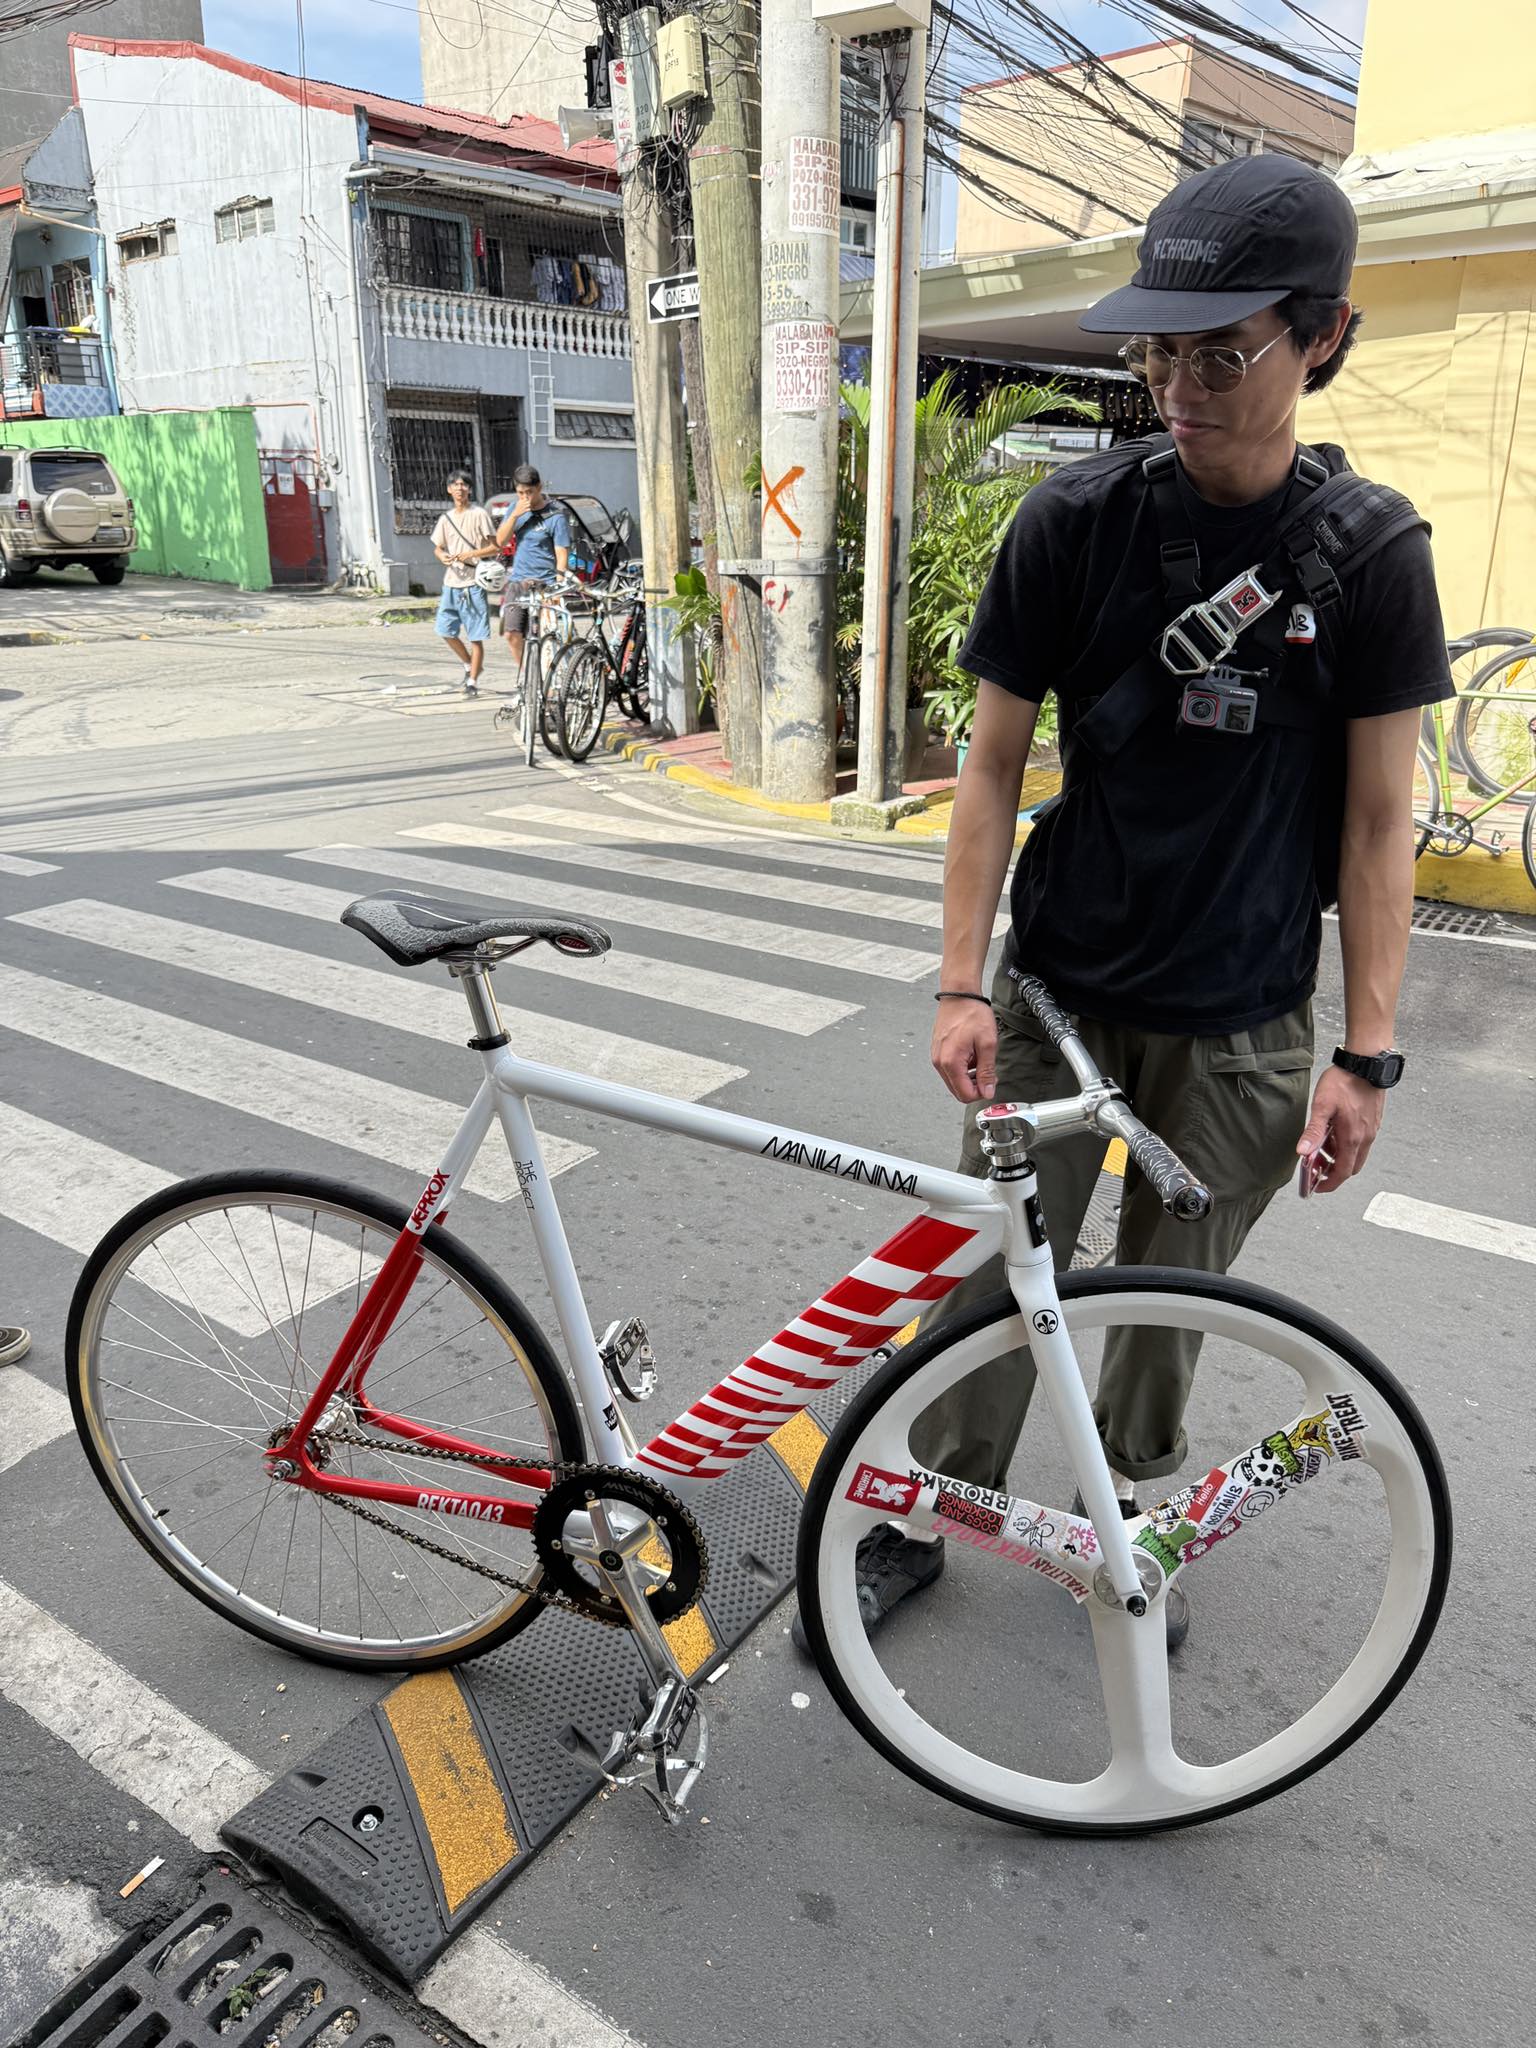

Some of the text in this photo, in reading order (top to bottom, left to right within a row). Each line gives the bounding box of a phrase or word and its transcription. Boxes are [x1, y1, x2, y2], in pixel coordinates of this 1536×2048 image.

[666, 289, 686, 306] ONE
[776, 342, 828, 354] SIP-SIP
[776, 355, 829, 368] POZO-NEGRO
[776, 369, 828, 396] 8330-2115
[1316, 520, 1343, 554] CHROME
[522, 1160, 538, 1183] THE
[760, 1136, 922, 1198] MANILA ANIMAL
[411, 1168, 450, 1231] JEPROX
[514, 1161, 536, 1210] PROJECT
[1326, 1394, 1368, 1436] TREAT
[1334, 1437, 1362, 1461] BIKE
[854, 1470, 873, 1498] CHROME
[909, 1470, 1010, 1510] BROSAKA
[1168, 1490, 1194, 1505] VANS
[1196, 1483, 1214, 1506] Hello
[417, 1493, 504, 1523] REKTA043
[938, 1492, 1004, 1526] LOCKRINGS
[939, 1504, 999, 1535] COGS AND
[1156, 1507, 1174, 1520] OFF
[1029, 1558, 1089, 1597] HALITAN
